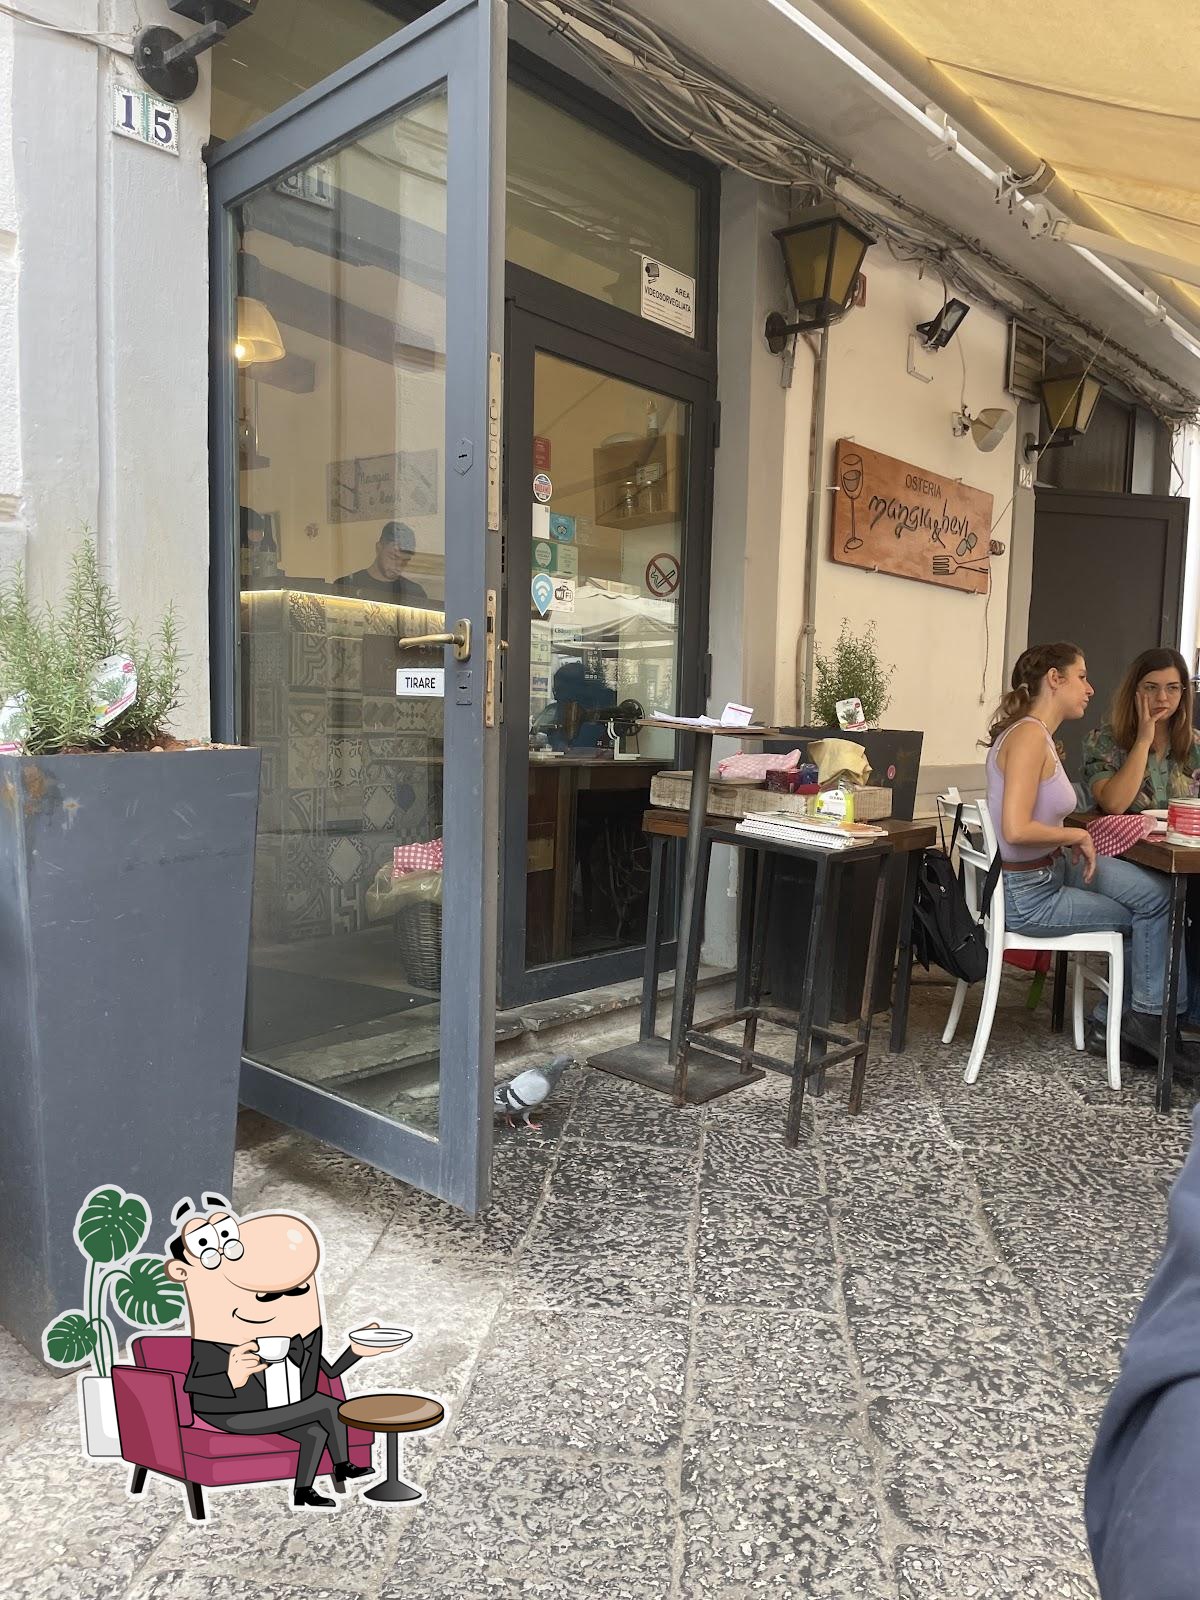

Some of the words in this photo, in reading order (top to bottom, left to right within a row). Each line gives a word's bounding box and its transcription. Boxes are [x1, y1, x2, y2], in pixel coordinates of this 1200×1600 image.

[121, 94, 173, 144] 15
[645, 285, 691, 313] VIDEOSORVEGLIATA
[675, 287, 691, 300] AREA
[905, 473, 942, 499] OSTERIA
[405, 677, 436, 689] TIRARE
